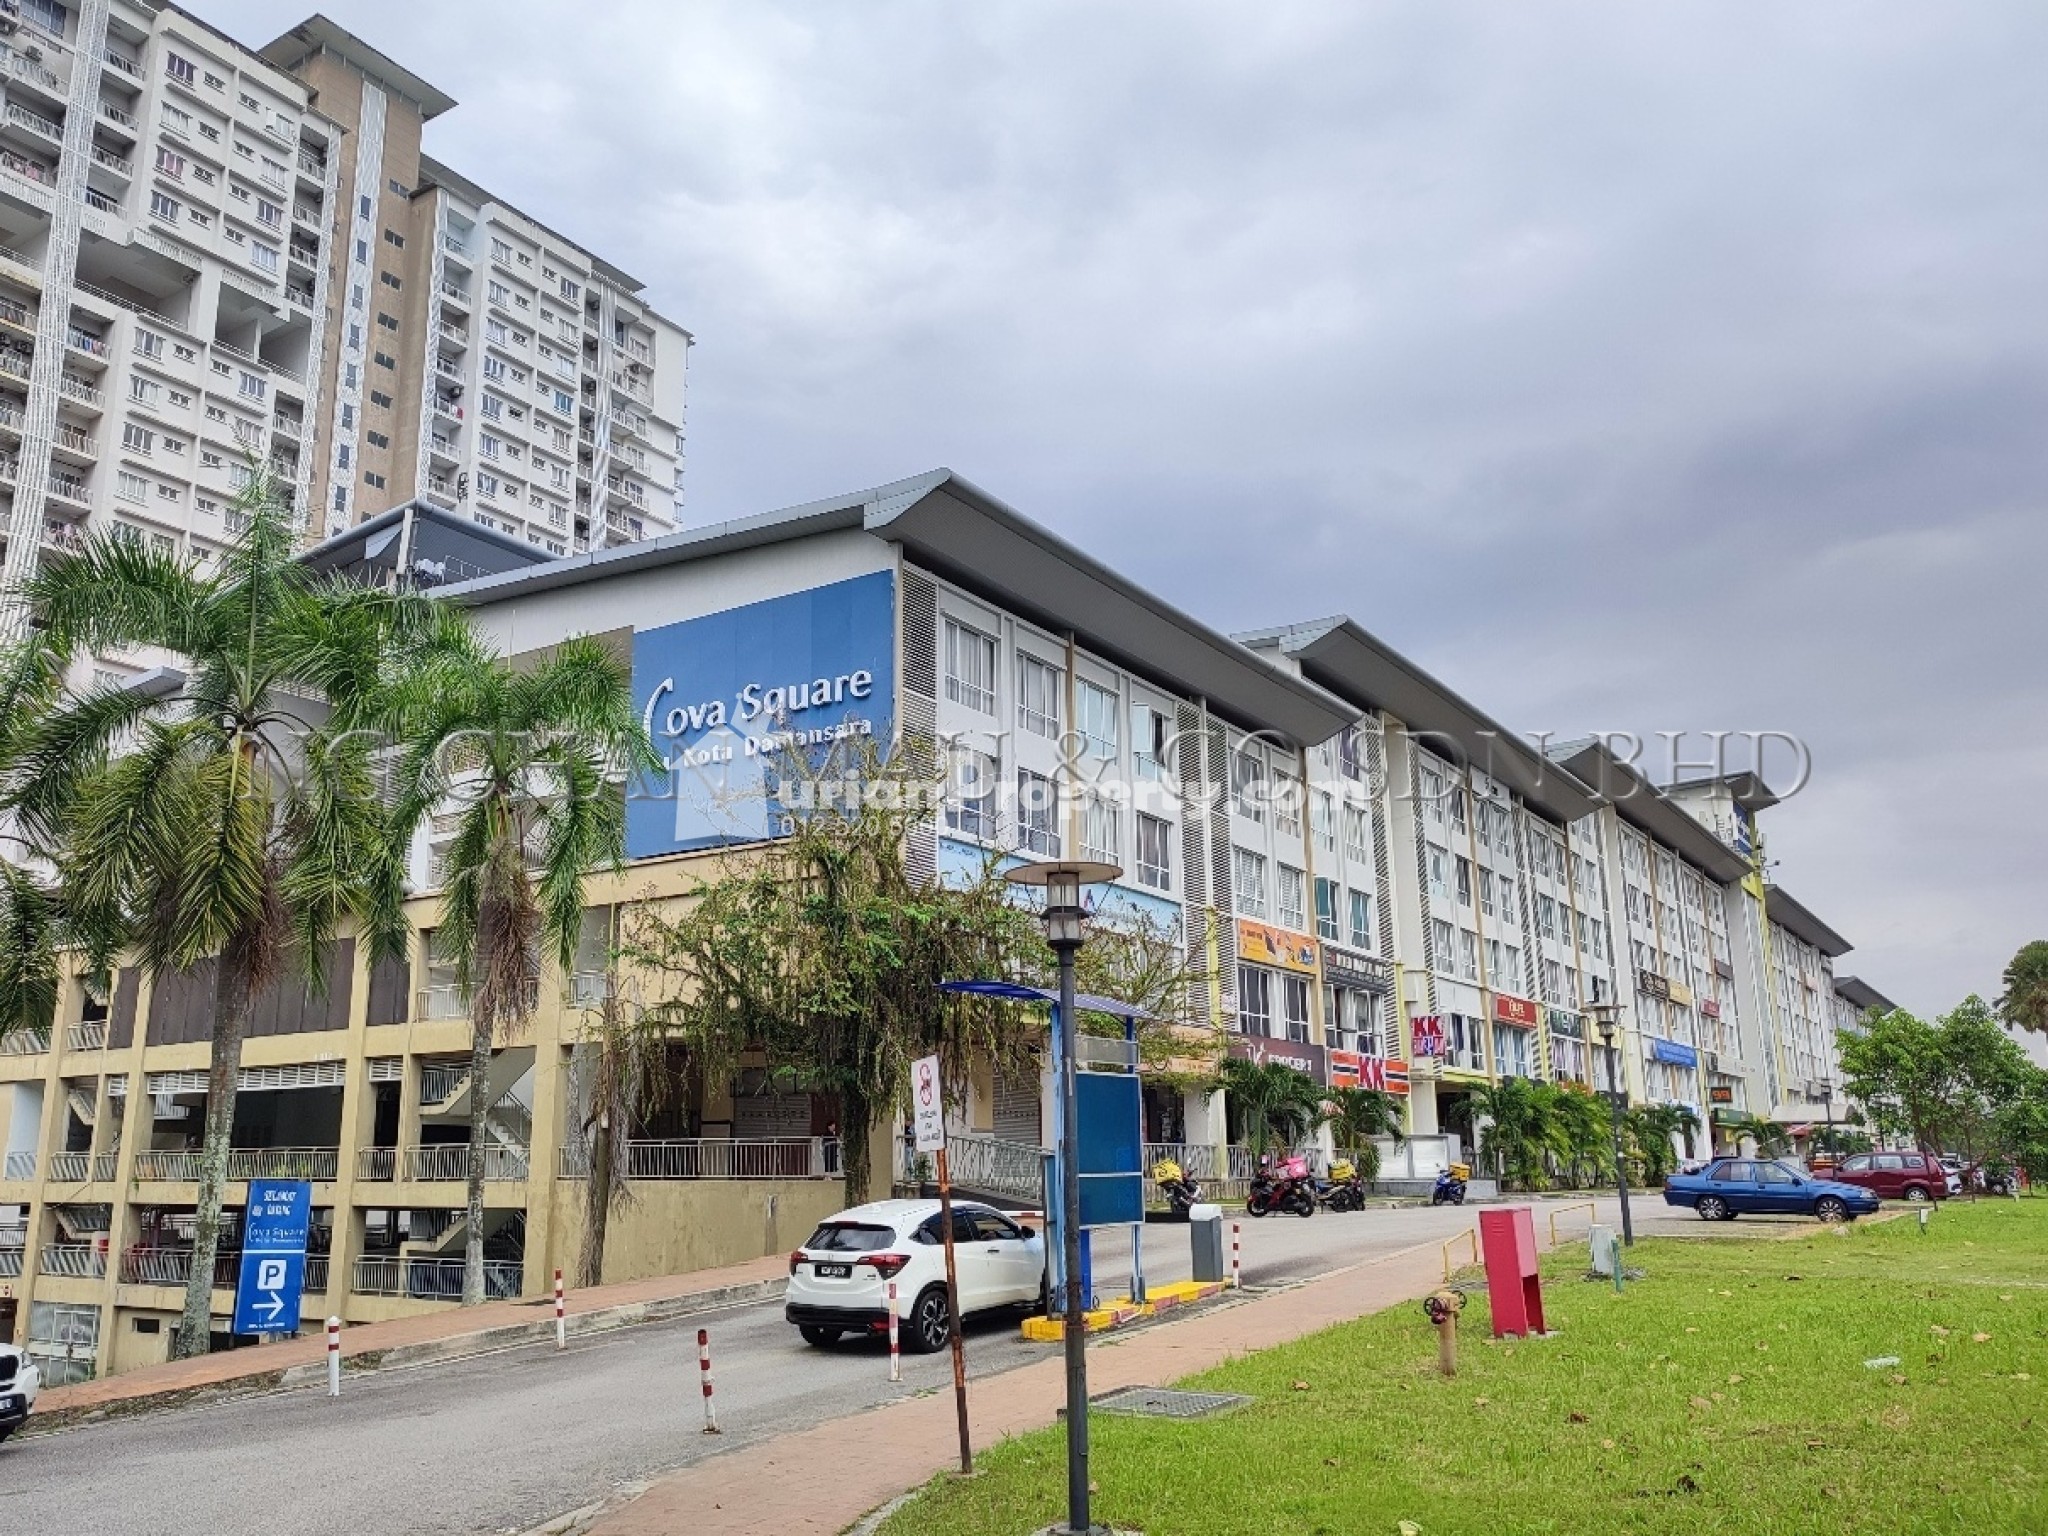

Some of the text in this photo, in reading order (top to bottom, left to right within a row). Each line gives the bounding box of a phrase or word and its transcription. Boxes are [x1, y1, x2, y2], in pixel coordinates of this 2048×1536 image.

[643, 669, 873, 770] Cova Square
[683, 744, 733, 768] Kota
[1359, 1056, 1384, 1090] KK
[264, 1265, 280, 1286] P
